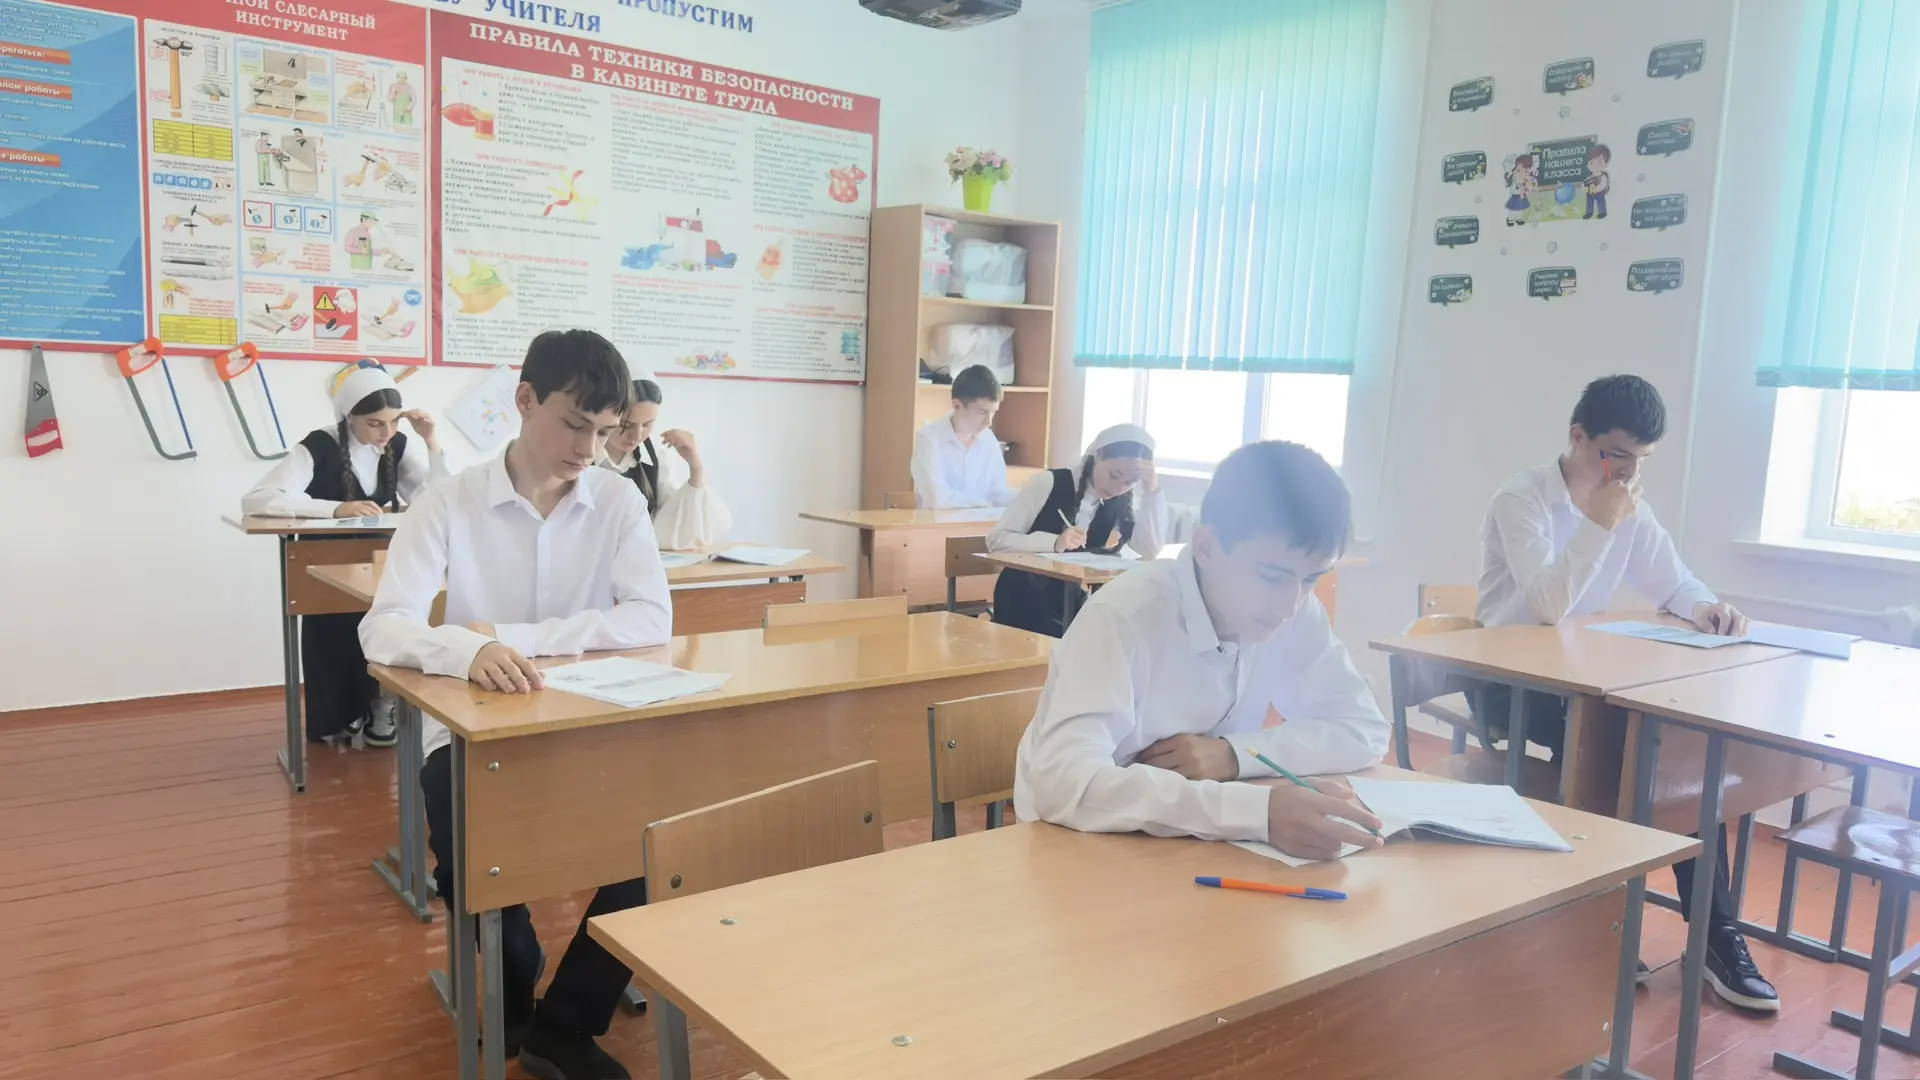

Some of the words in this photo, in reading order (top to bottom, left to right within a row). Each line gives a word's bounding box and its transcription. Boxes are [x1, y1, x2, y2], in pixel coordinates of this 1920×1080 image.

[236, 10, 350, 40] ИНСТРУМЕНТ
[275, 1, 376, 30] СЛЕСАРНЫЙ
[485, 0, 600, 32] УЧИТЕЛЯ
[469, 22, 581, 58] ПРАВИЛА
[588, 45, 694, 80] ТЕХНИКИ
[701, 67, 854, 111] БЕЗОПАСНОСТИ
[24, 84, 60, 95] работы
[570, 64, 585, 79] В
[592, 67, 708, 102] КАБИНЕТЕ
[714, 90, 778, 116] ТРУДА
[10, 154, 45, 162] работы
[1542, 146, 1586, 160] Правила
[1544, 157, 1583, 169] нашего
[1544, 167, 1582, 180] класса
